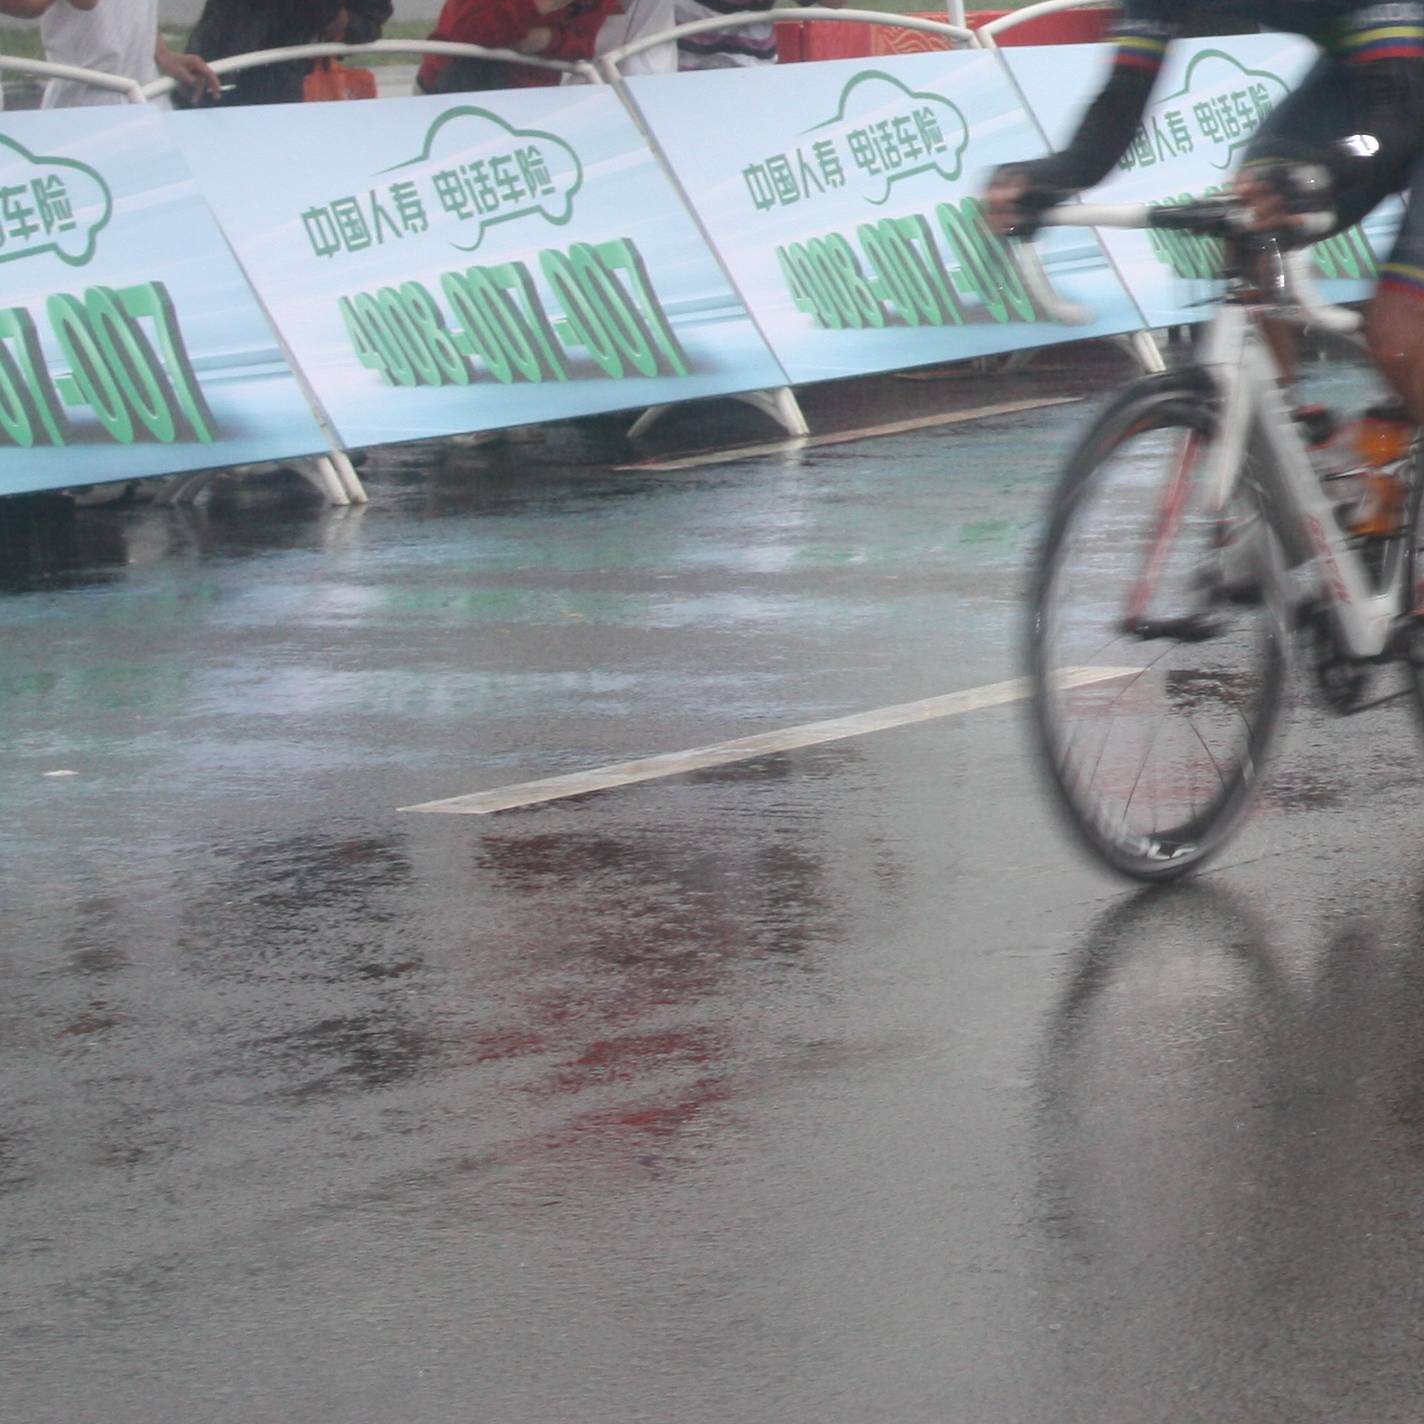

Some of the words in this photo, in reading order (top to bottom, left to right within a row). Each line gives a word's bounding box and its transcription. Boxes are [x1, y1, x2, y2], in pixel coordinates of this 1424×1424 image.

[0, 173, 77, 246] 车险
[301, 180, 429, 259] 中国人寿
[438, 143, 557, 223] 电话车险
[741, 141, 846, 213] 中国人寿
[846, 106, 947, 176] 电话车险
[337, 237, 693, 387] 4008-007-007
[776, 196, 1041, 329] 4008-007-00
